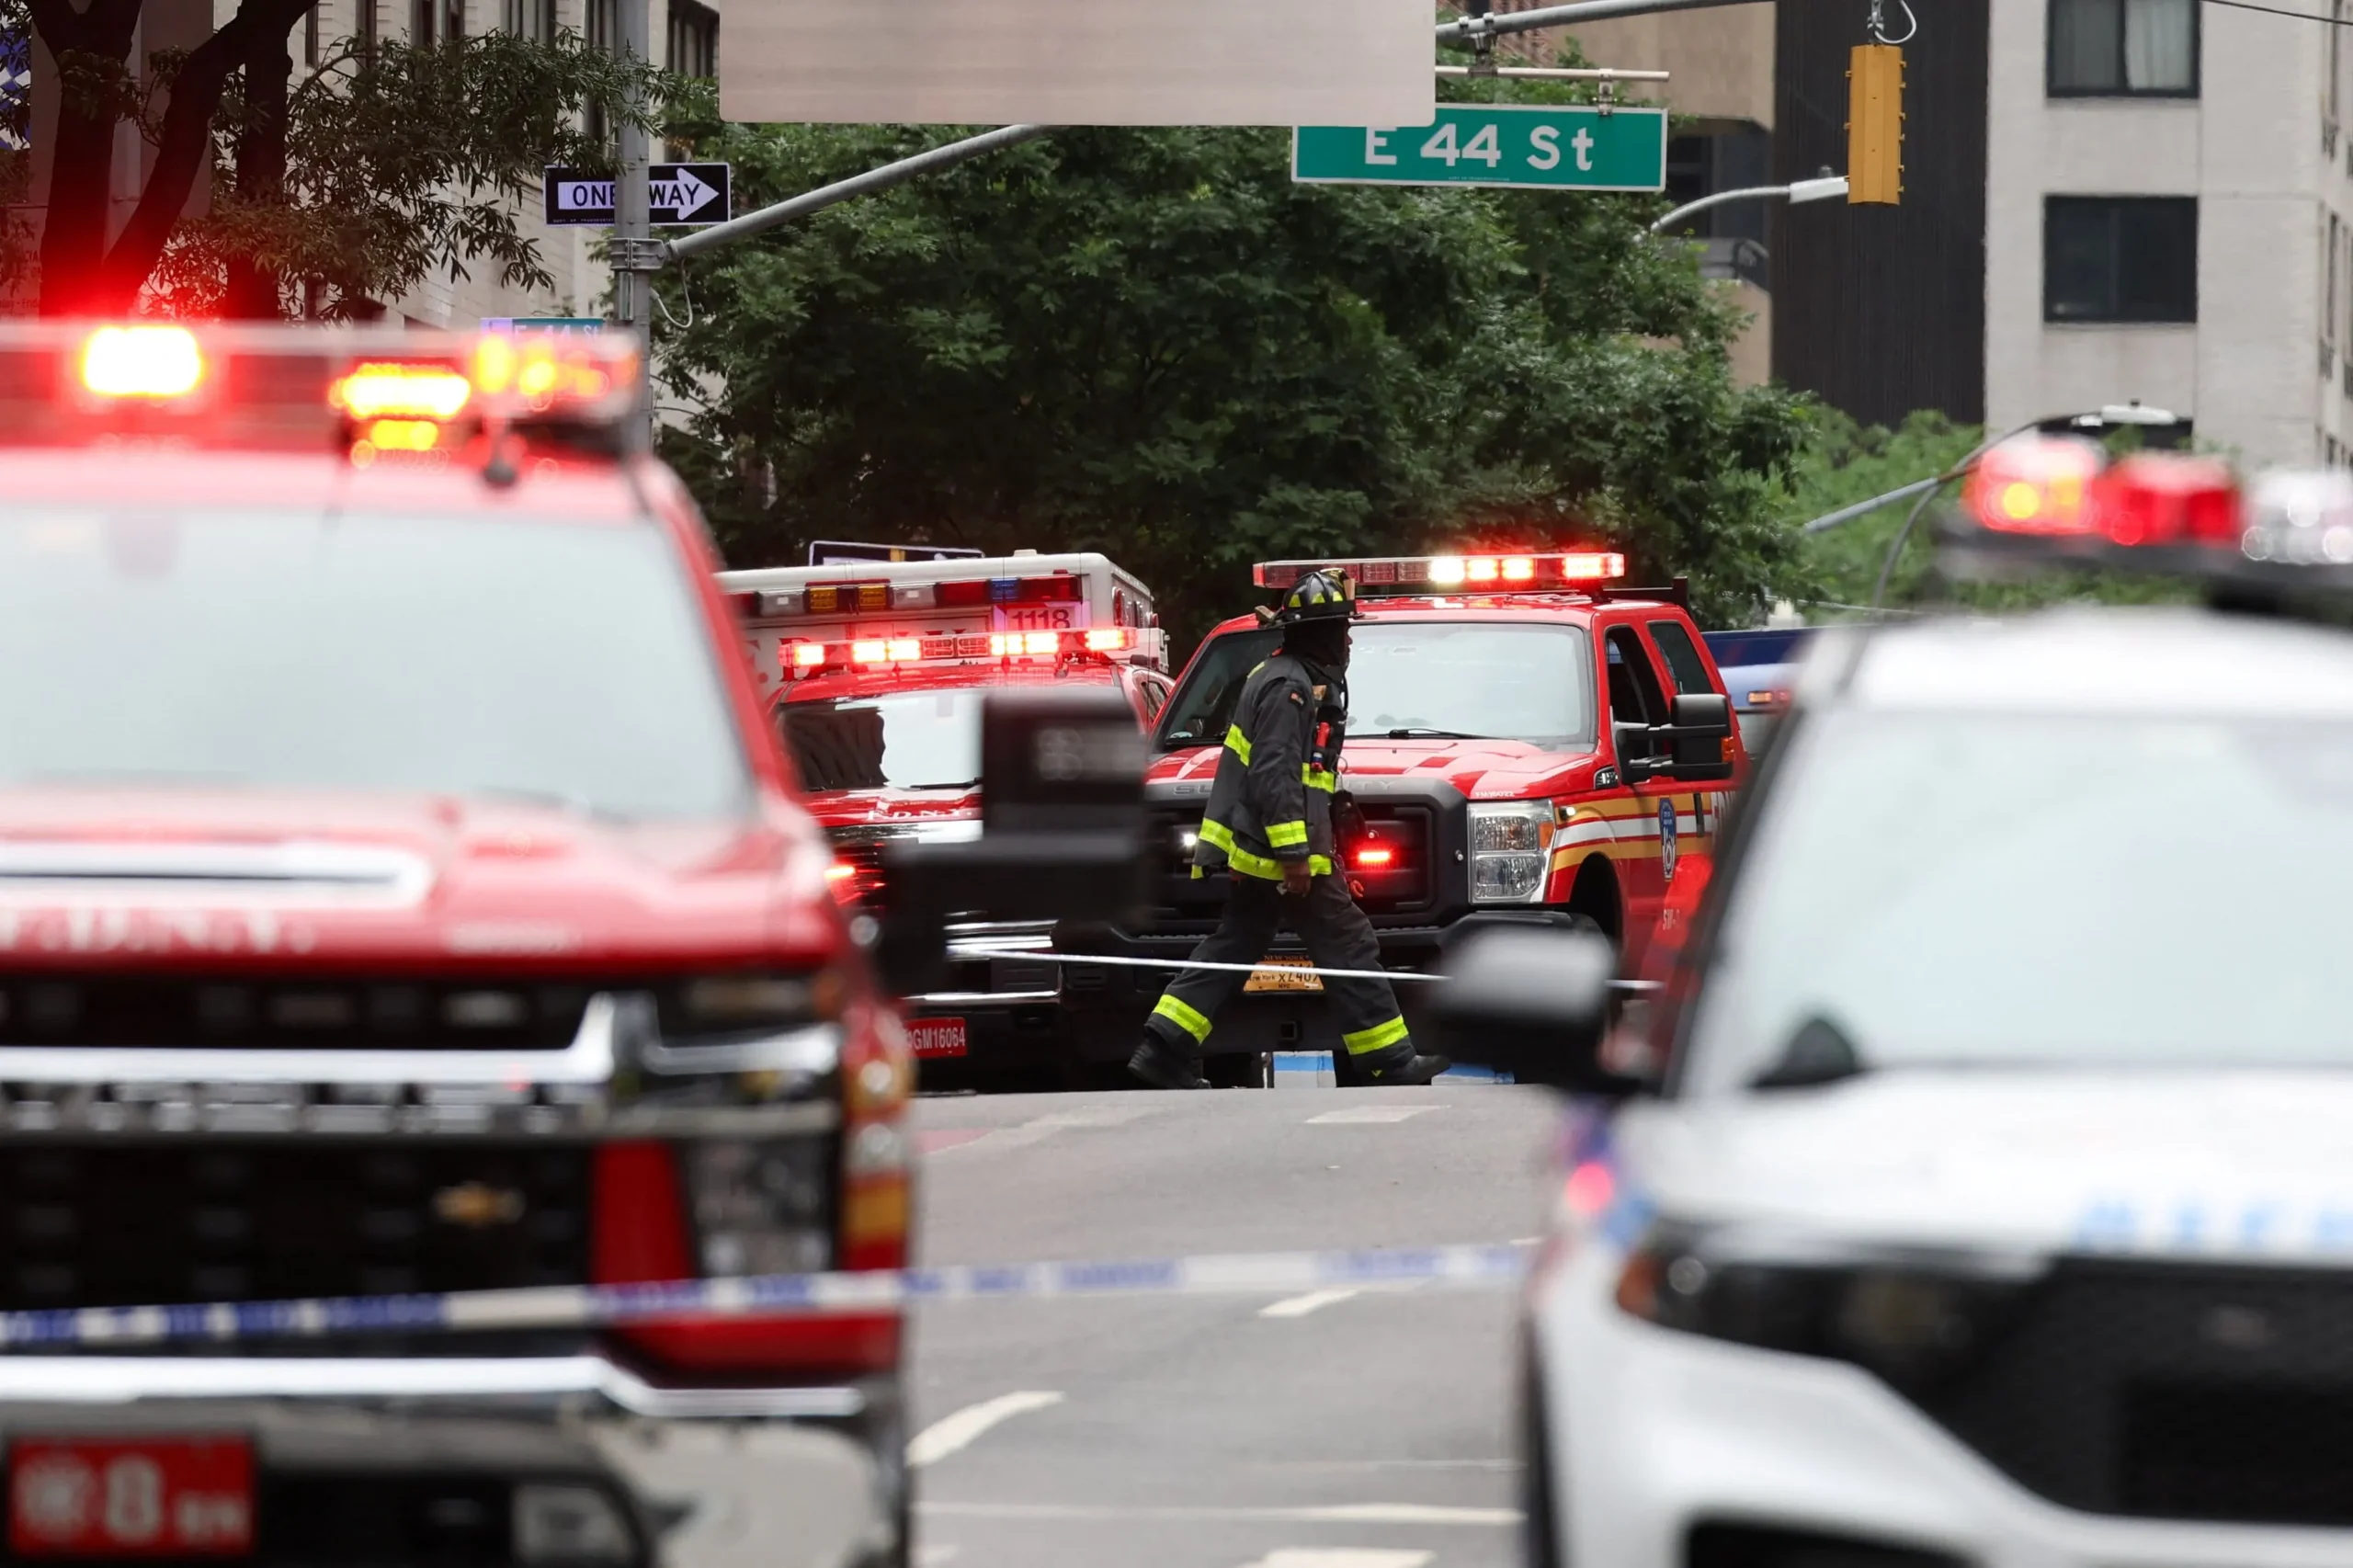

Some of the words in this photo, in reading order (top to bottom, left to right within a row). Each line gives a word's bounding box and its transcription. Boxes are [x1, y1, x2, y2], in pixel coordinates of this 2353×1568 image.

[1365, 127, 1397, 165] E
[1420, 123, 1502, 167] 44
[1527, 125, 1595, 172] St
[649, 184, 699, 206] WAY
[1012, 608, 1071, 631] 1118
